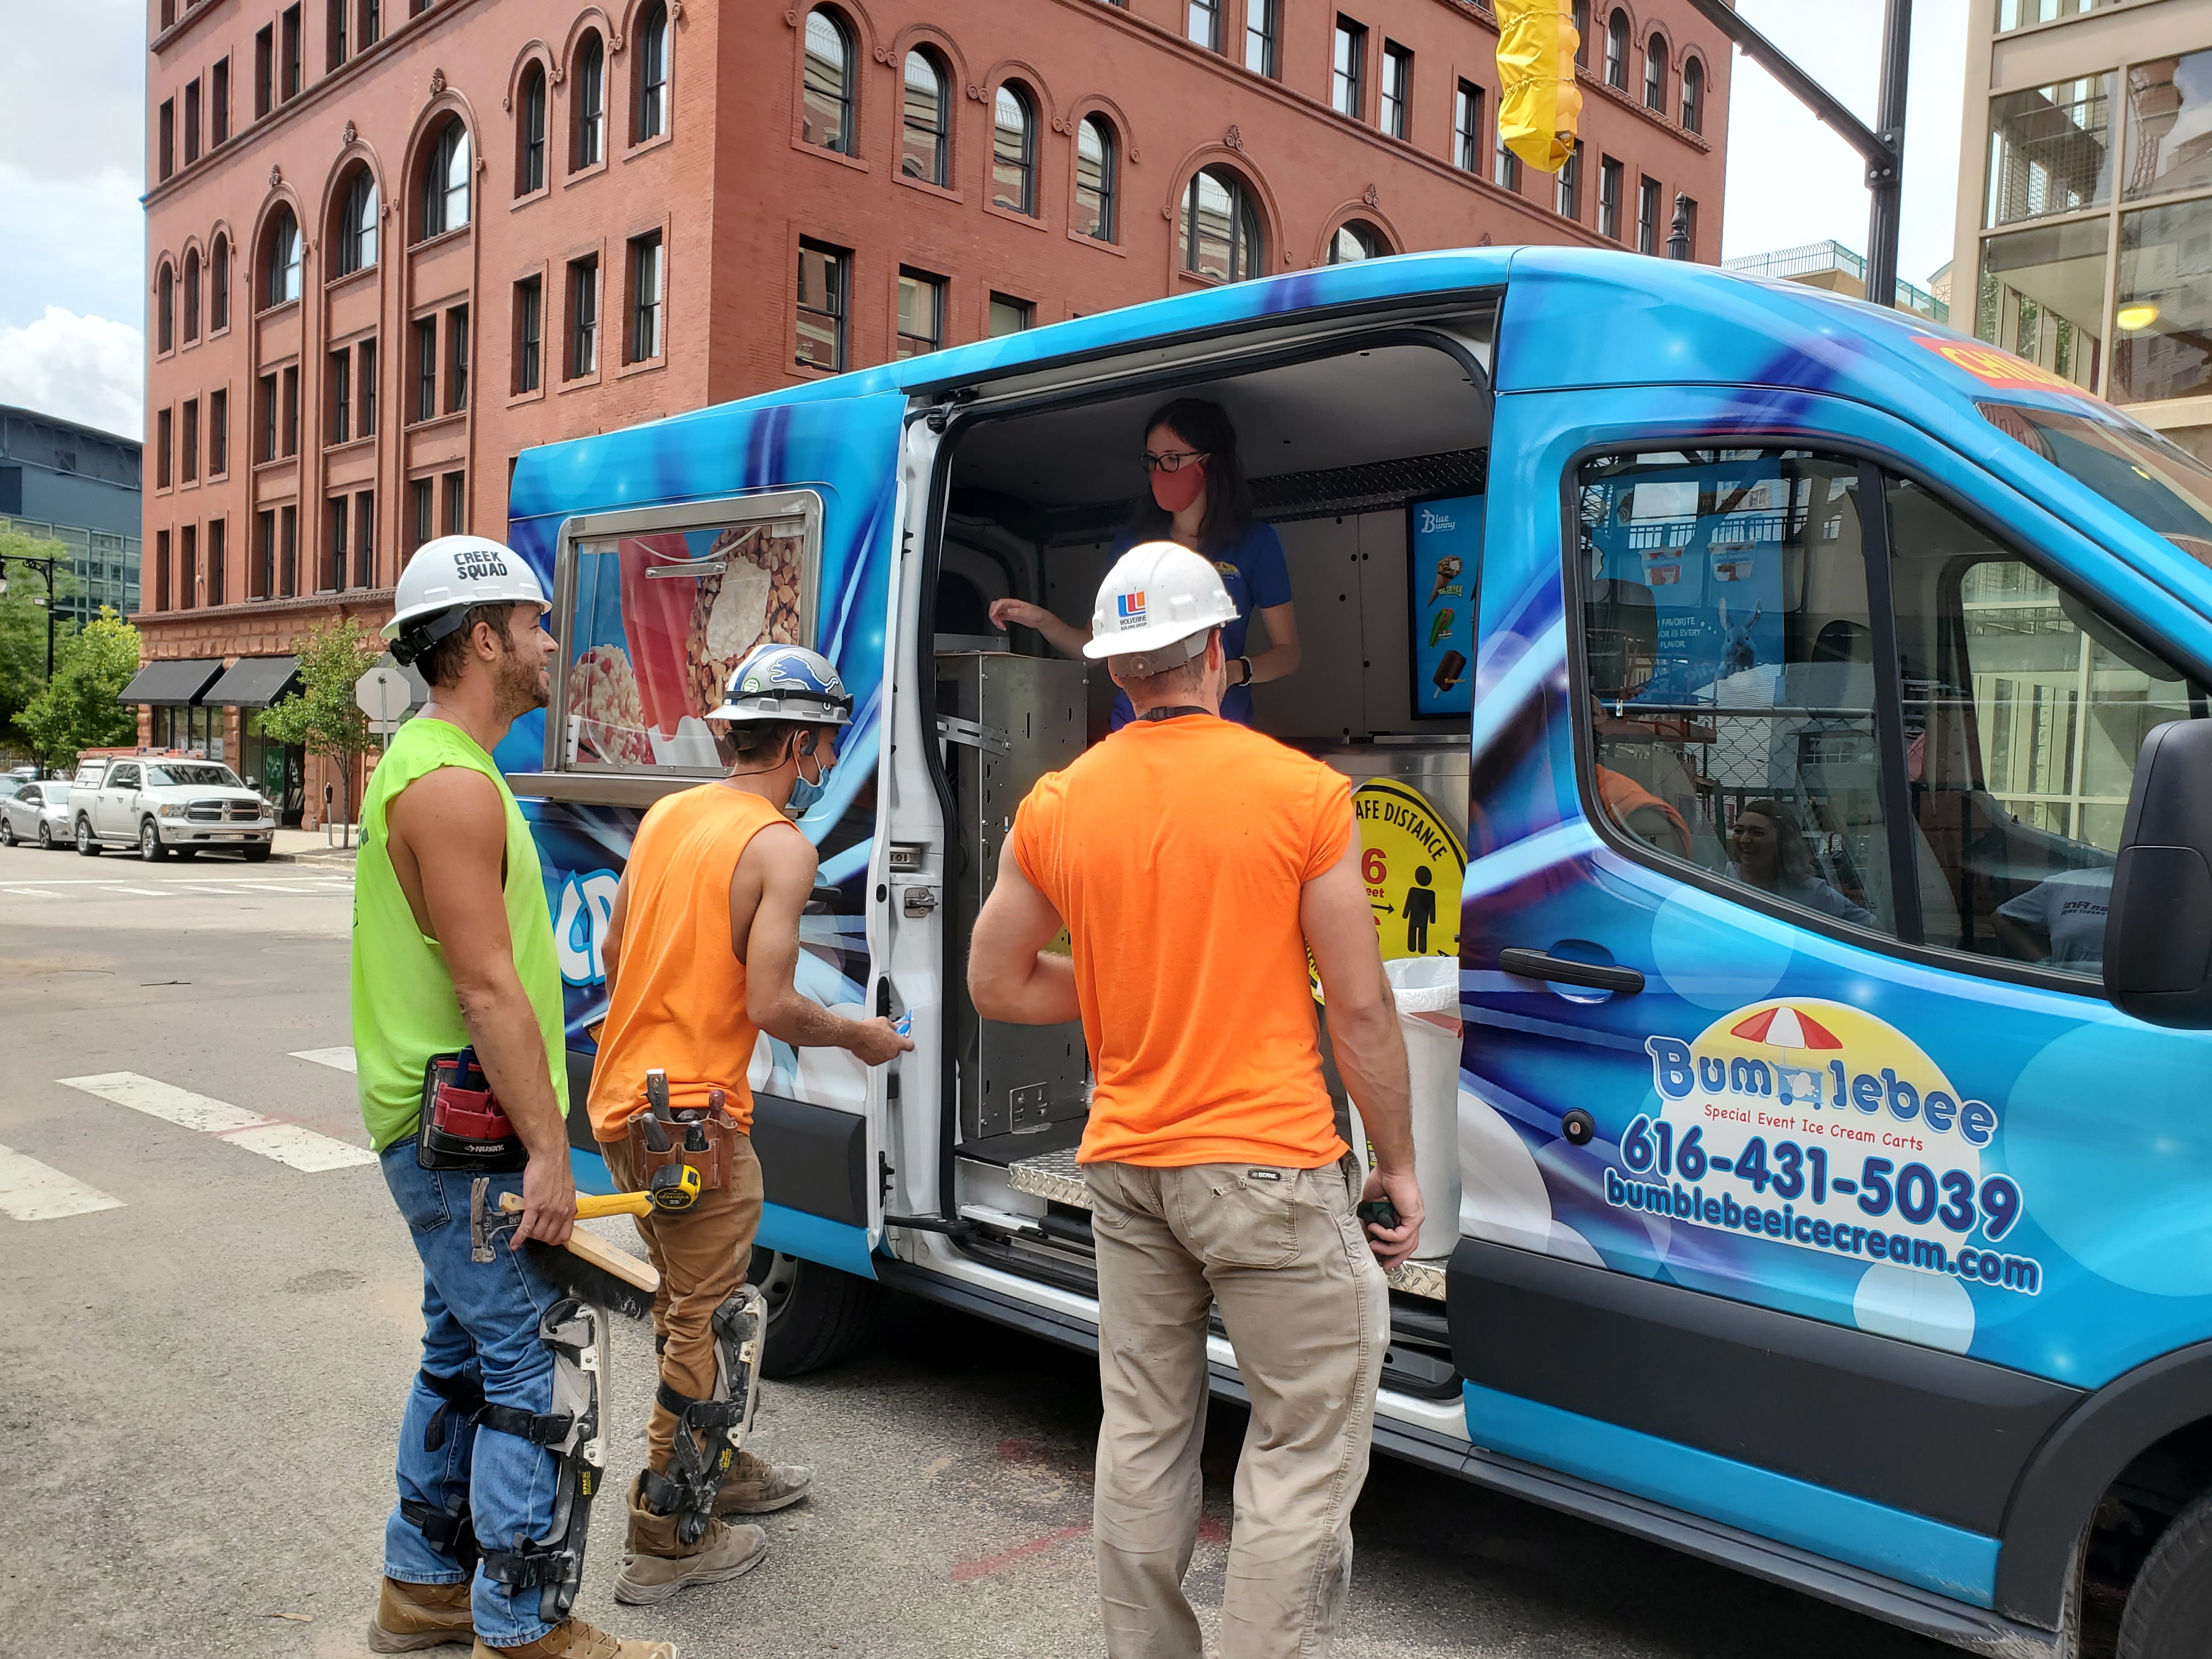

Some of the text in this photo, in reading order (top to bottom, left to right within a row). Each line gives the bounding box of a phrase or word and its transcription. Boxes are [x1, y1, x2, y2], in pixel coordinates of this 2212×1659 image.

[454, 551, 503, 566] CREEK
[457, 563, 508, 580] SQUAD
[1120, 615, 1147, 626] WOLVERINE
[1662, 617, 1695, 627] FAVORITE
[1671, 629, 1678, 638] IS
[1680, 629, 1701, 637] EVERY
[1660, 640, 1686, 649] FLAVOR
[1356, 800, 1448, 862] AFE DISTANCE
[1362, 848, 1387, 885] 6
[1365, 888, 1385, 898] eet
[1704, 1104, 1923, 1151] Special Event Ice Cream Carts
[1623, 1116, 2021, 1241] 616-431-5039
[1606, 1172, 2039, 1291] bumblebeeicecream.com
